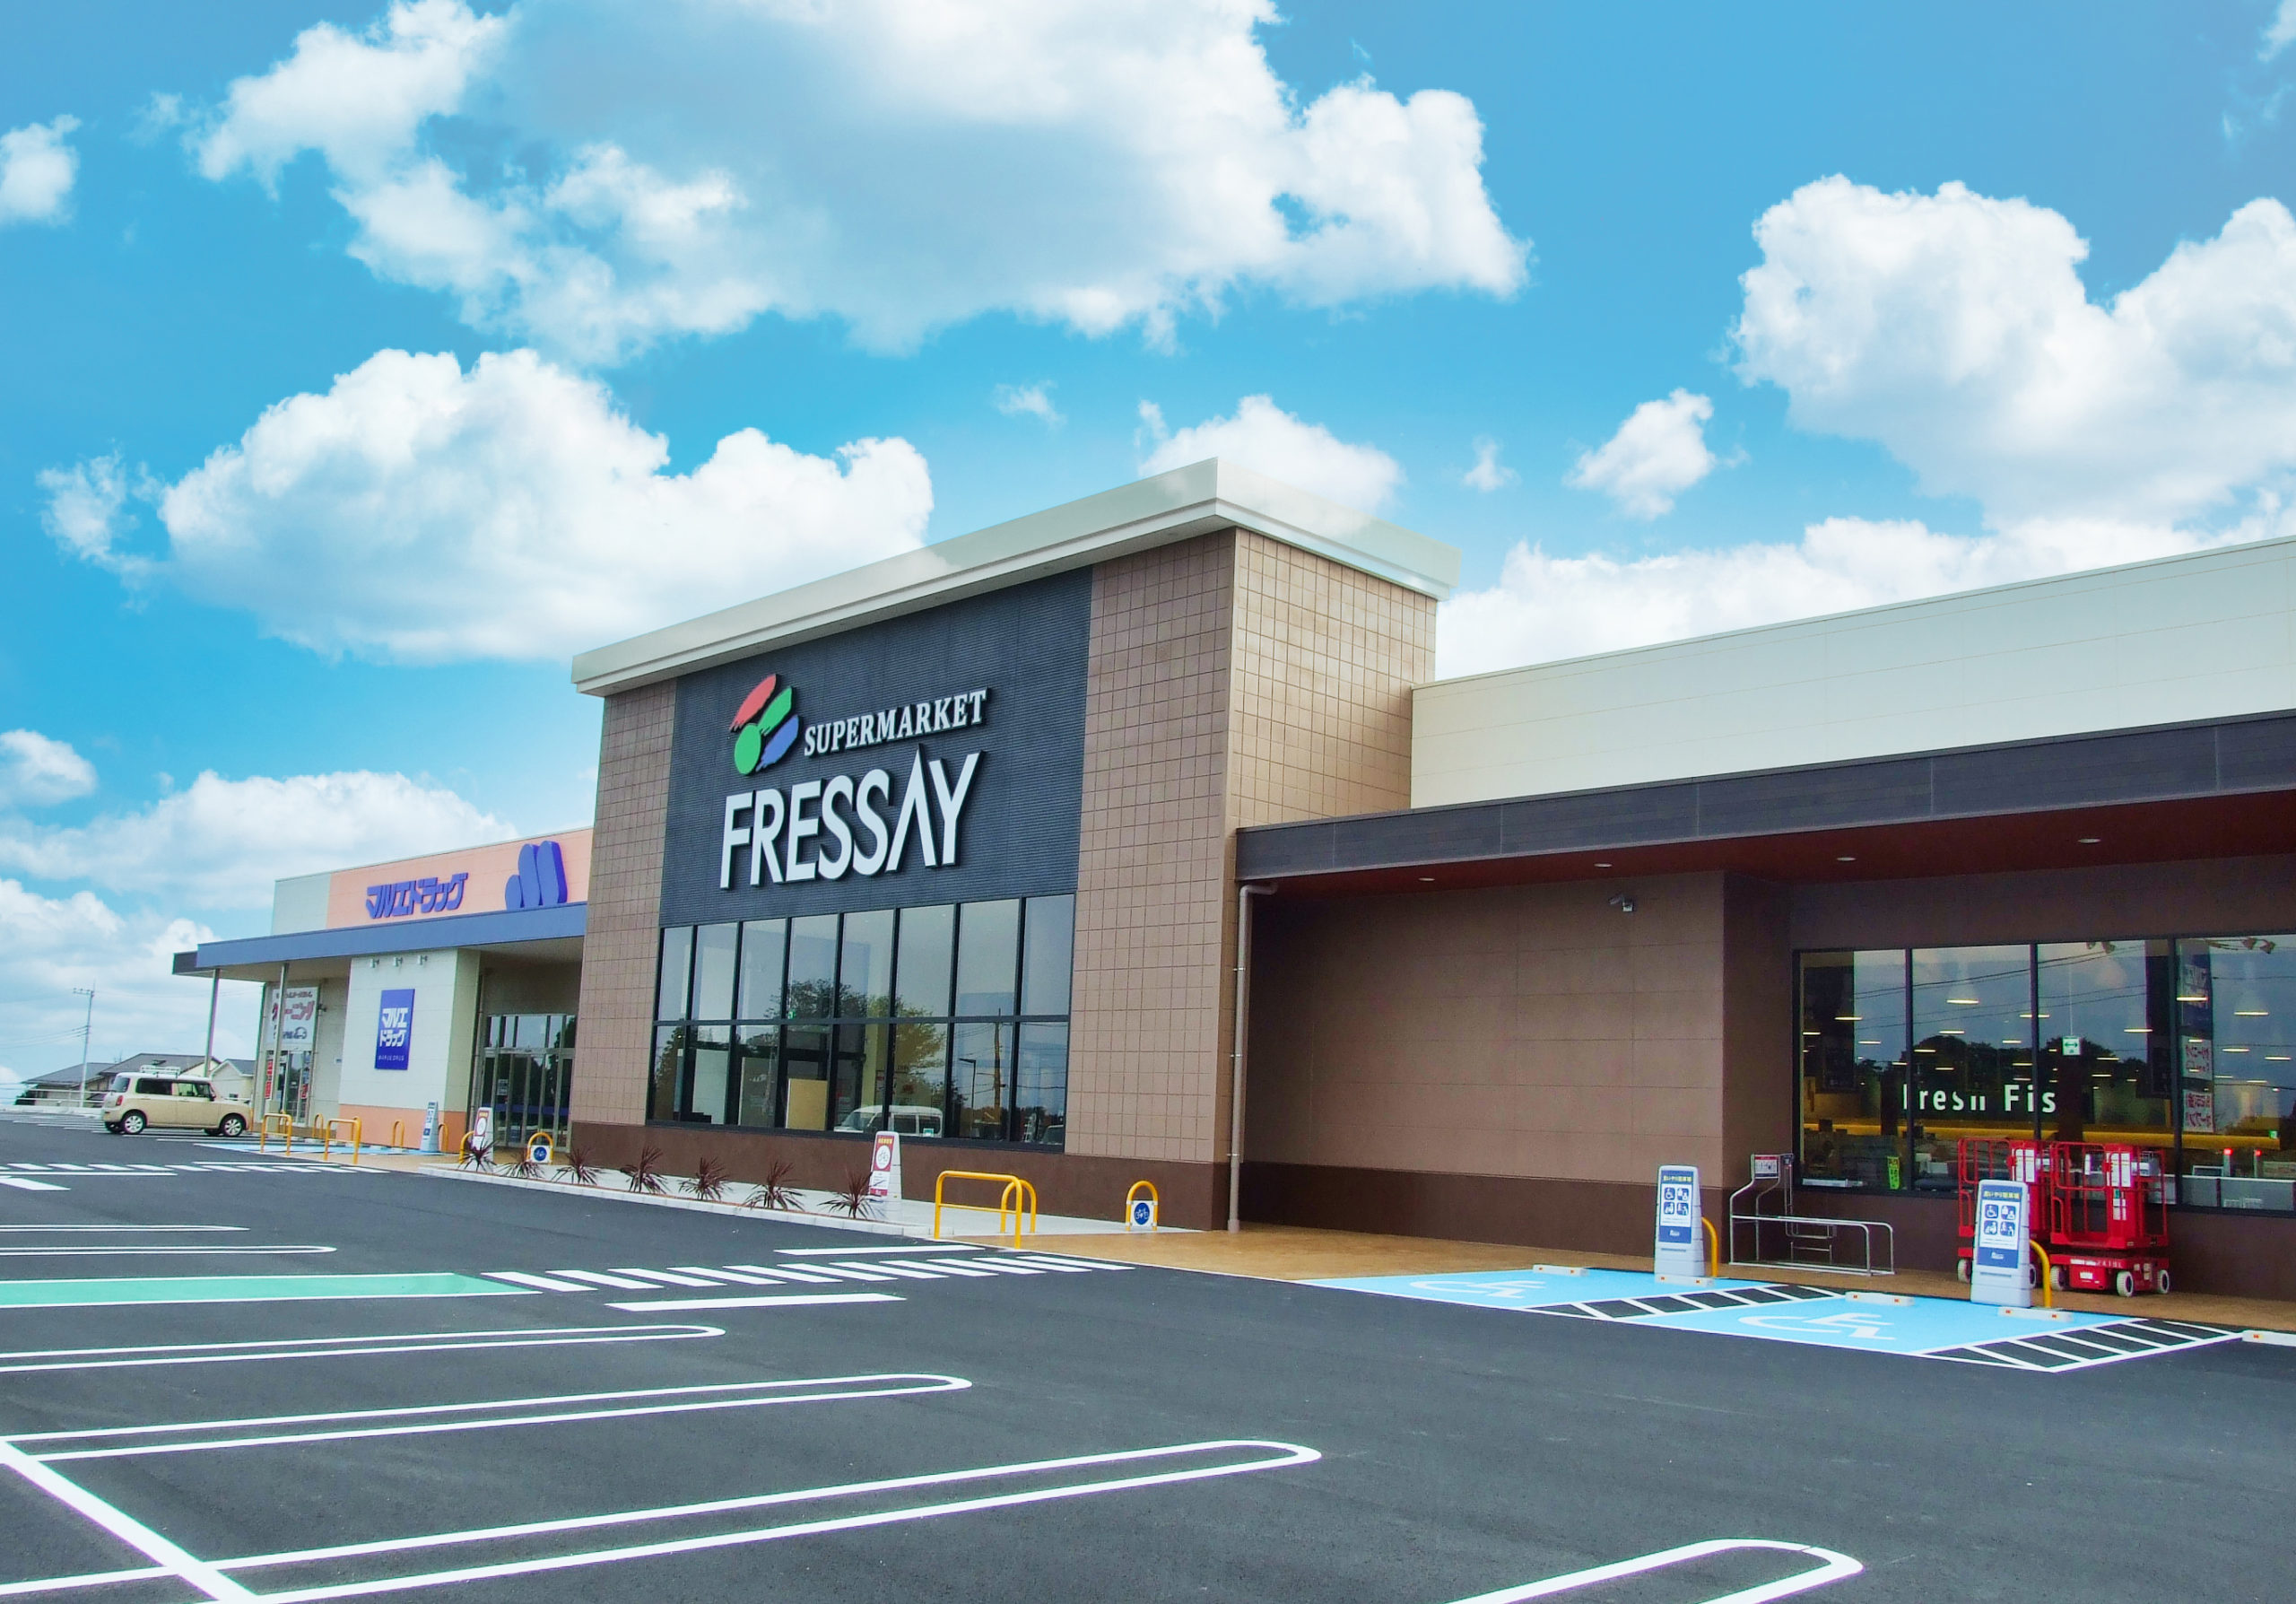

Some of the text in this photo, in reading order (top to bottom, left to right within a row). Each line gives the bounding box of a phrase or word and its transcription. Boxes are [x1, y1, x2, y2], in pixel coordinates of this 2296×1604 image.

[804, 688, 987, 757] SUPERMARKET
[720, 747, 982, 889] FRESSAY
[366, 872, 468, 919] マルエドラッグ
[379, 1030, 407, 1047] ドラッグ
[382, 1007, 409, 1028] マルエ
